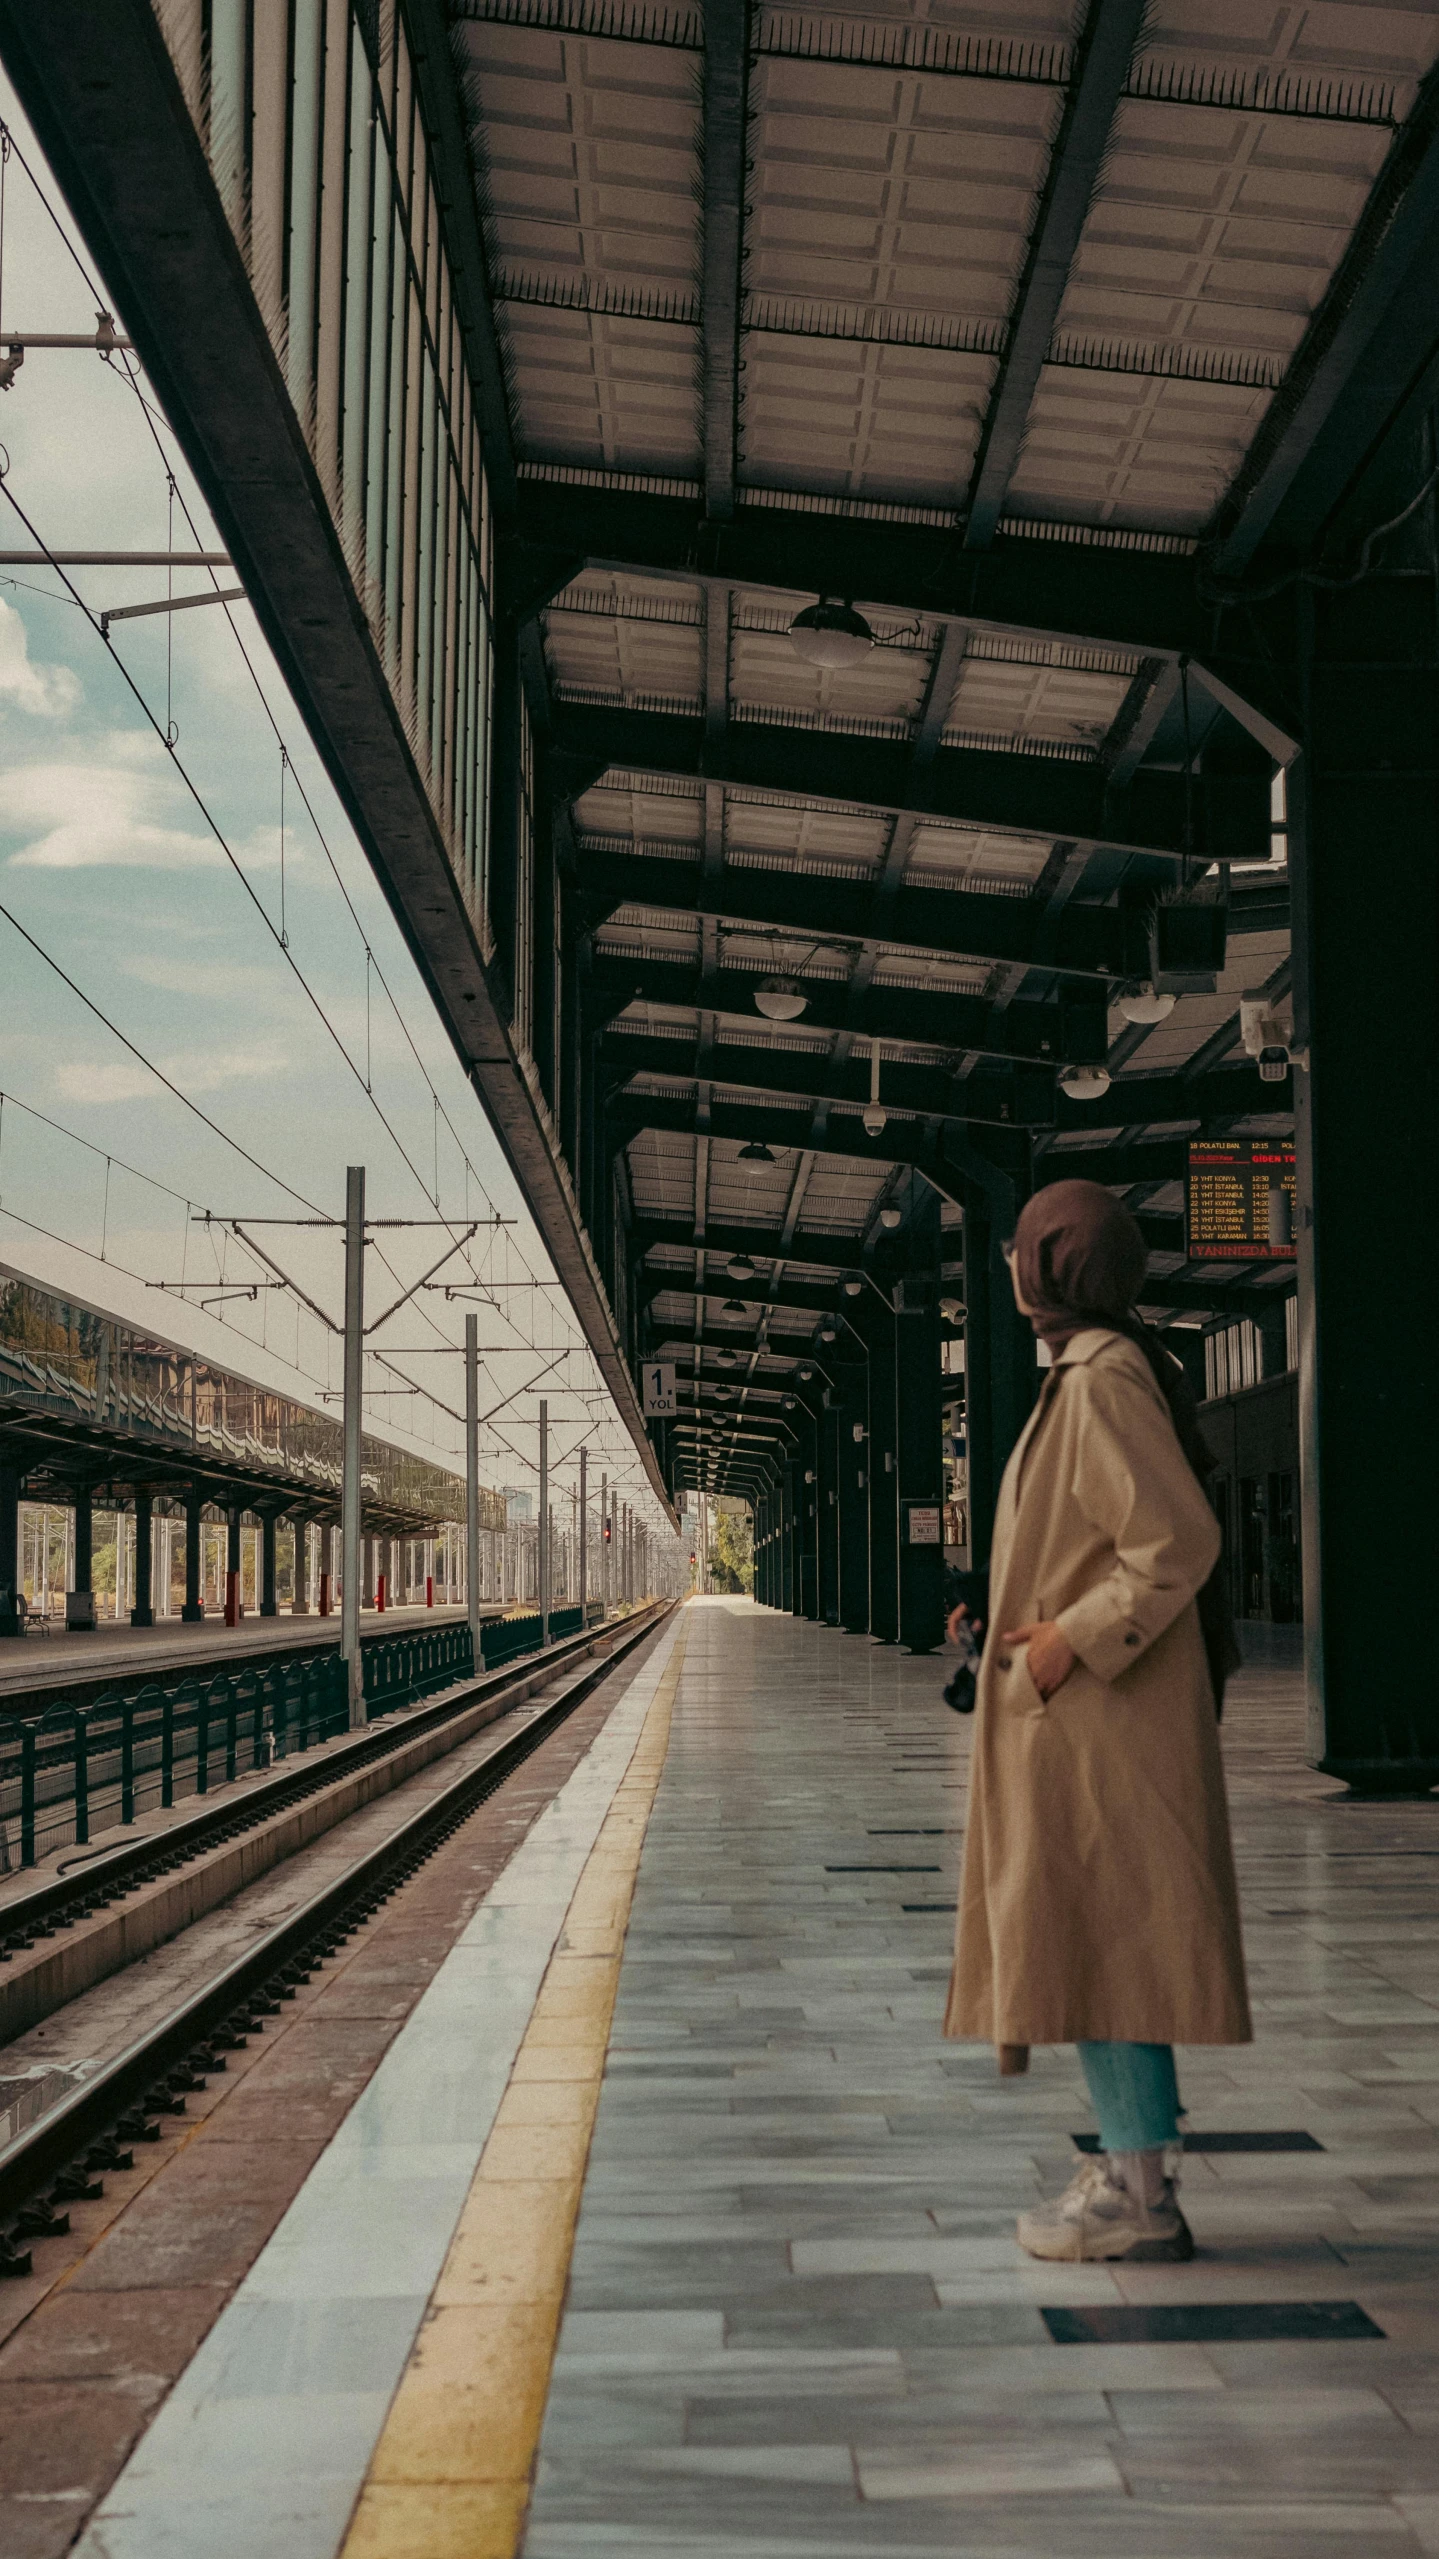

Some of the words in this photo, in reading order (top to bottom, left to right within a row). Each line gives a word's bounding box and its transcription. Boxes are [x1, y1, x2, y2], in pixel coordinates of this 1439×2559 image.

[1252, 1154, 1281, 1163] GİDEN
[1196, 1246, 1268, 1256] YANINIZDA
[652, 1369, 673, 1396] 1.
[649, 1400, 674, 1409] YOL
[677, 1495, 687, 1506] 1.
